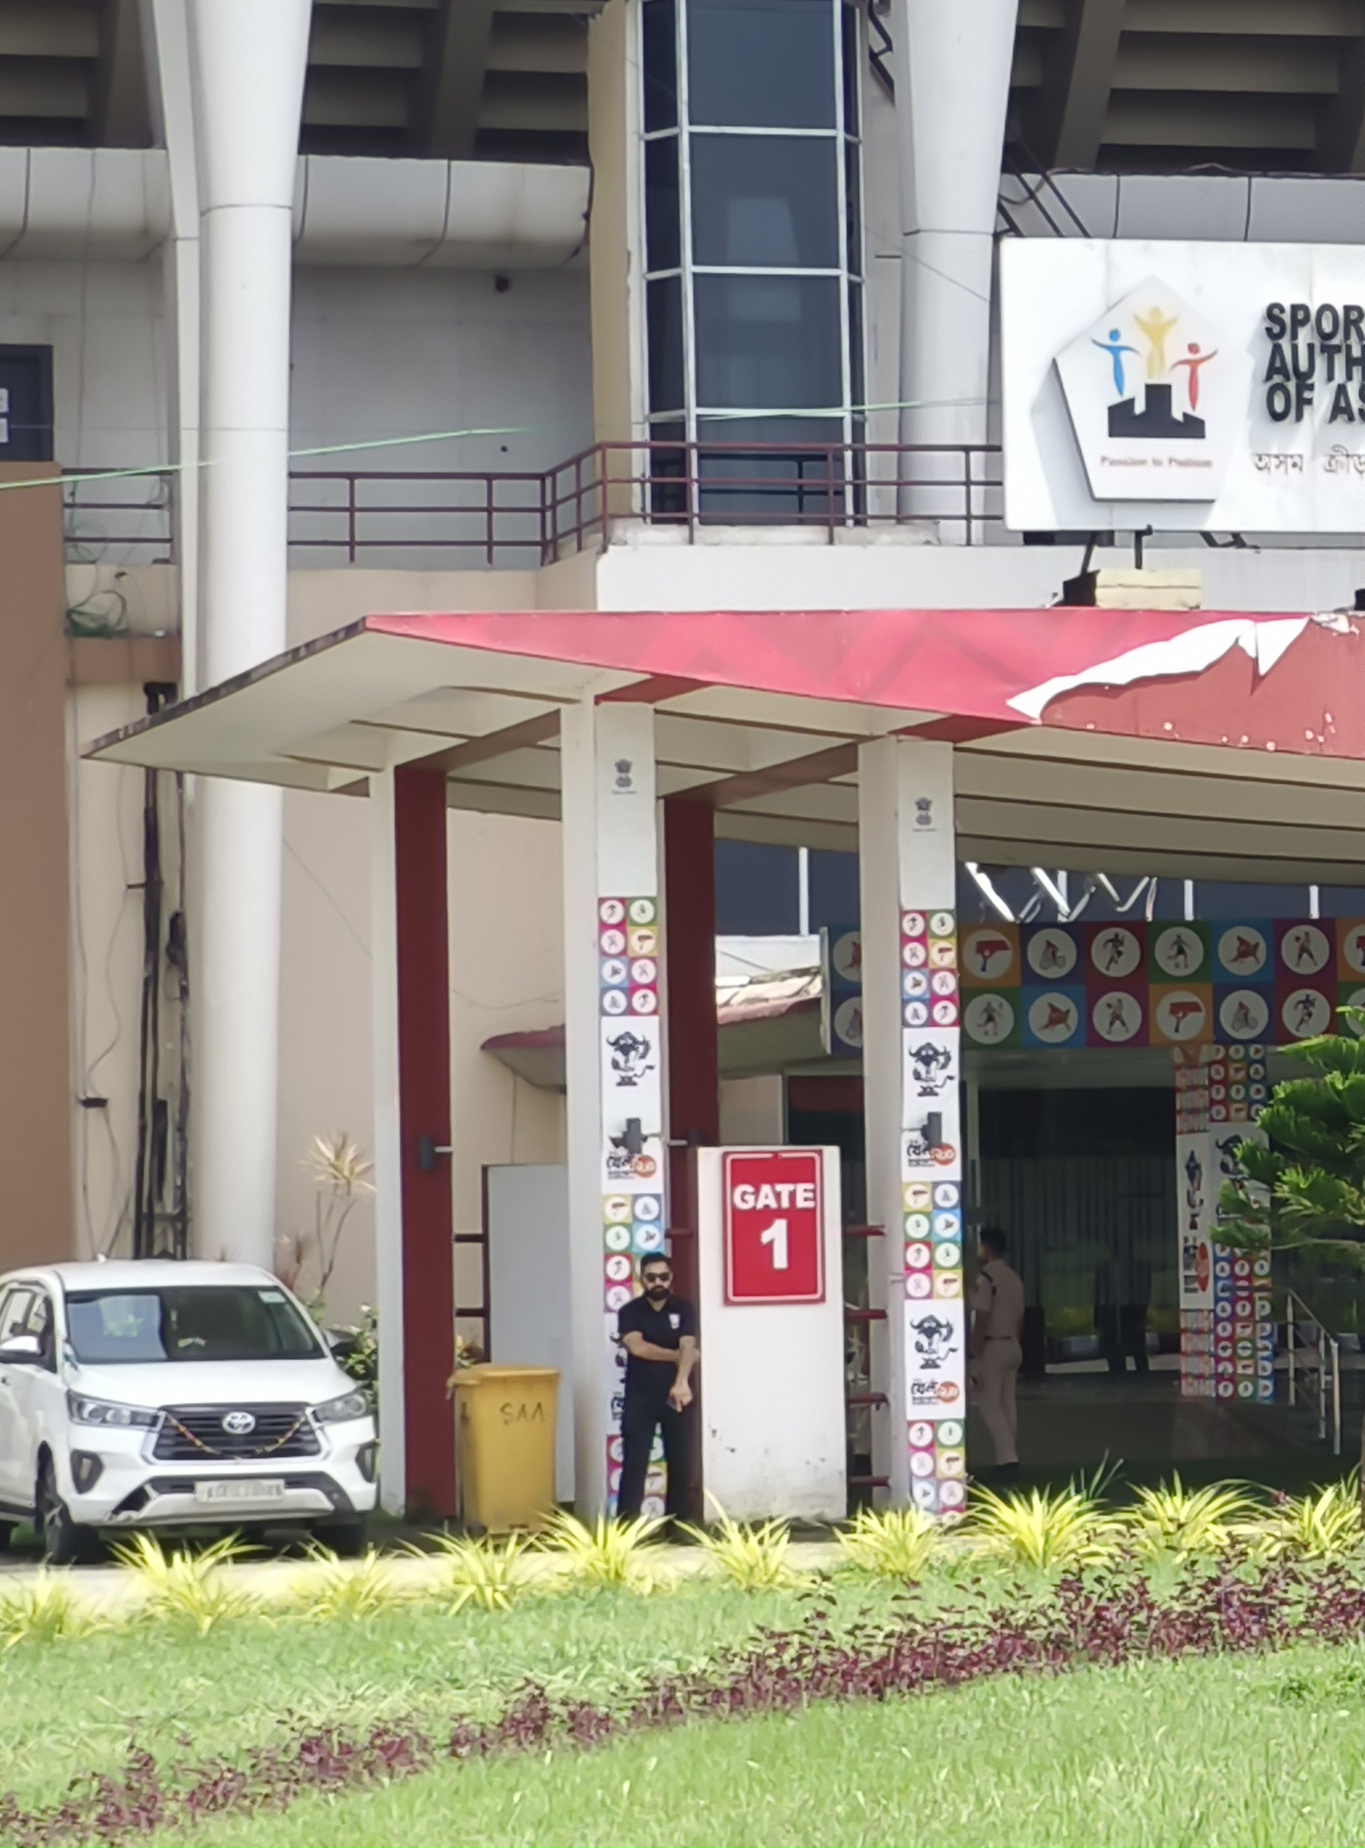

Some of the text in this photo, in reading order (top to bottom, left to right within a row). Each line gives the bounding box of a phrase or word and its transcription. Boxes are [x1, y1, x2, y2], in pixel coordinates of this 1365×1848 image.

[1265, 380, 1315, 423] OF
[1253, 452, 1304, 475] অসম
[732, 1182, 817, 1212] GATE
[760, 1218, 790, 1271] 1
